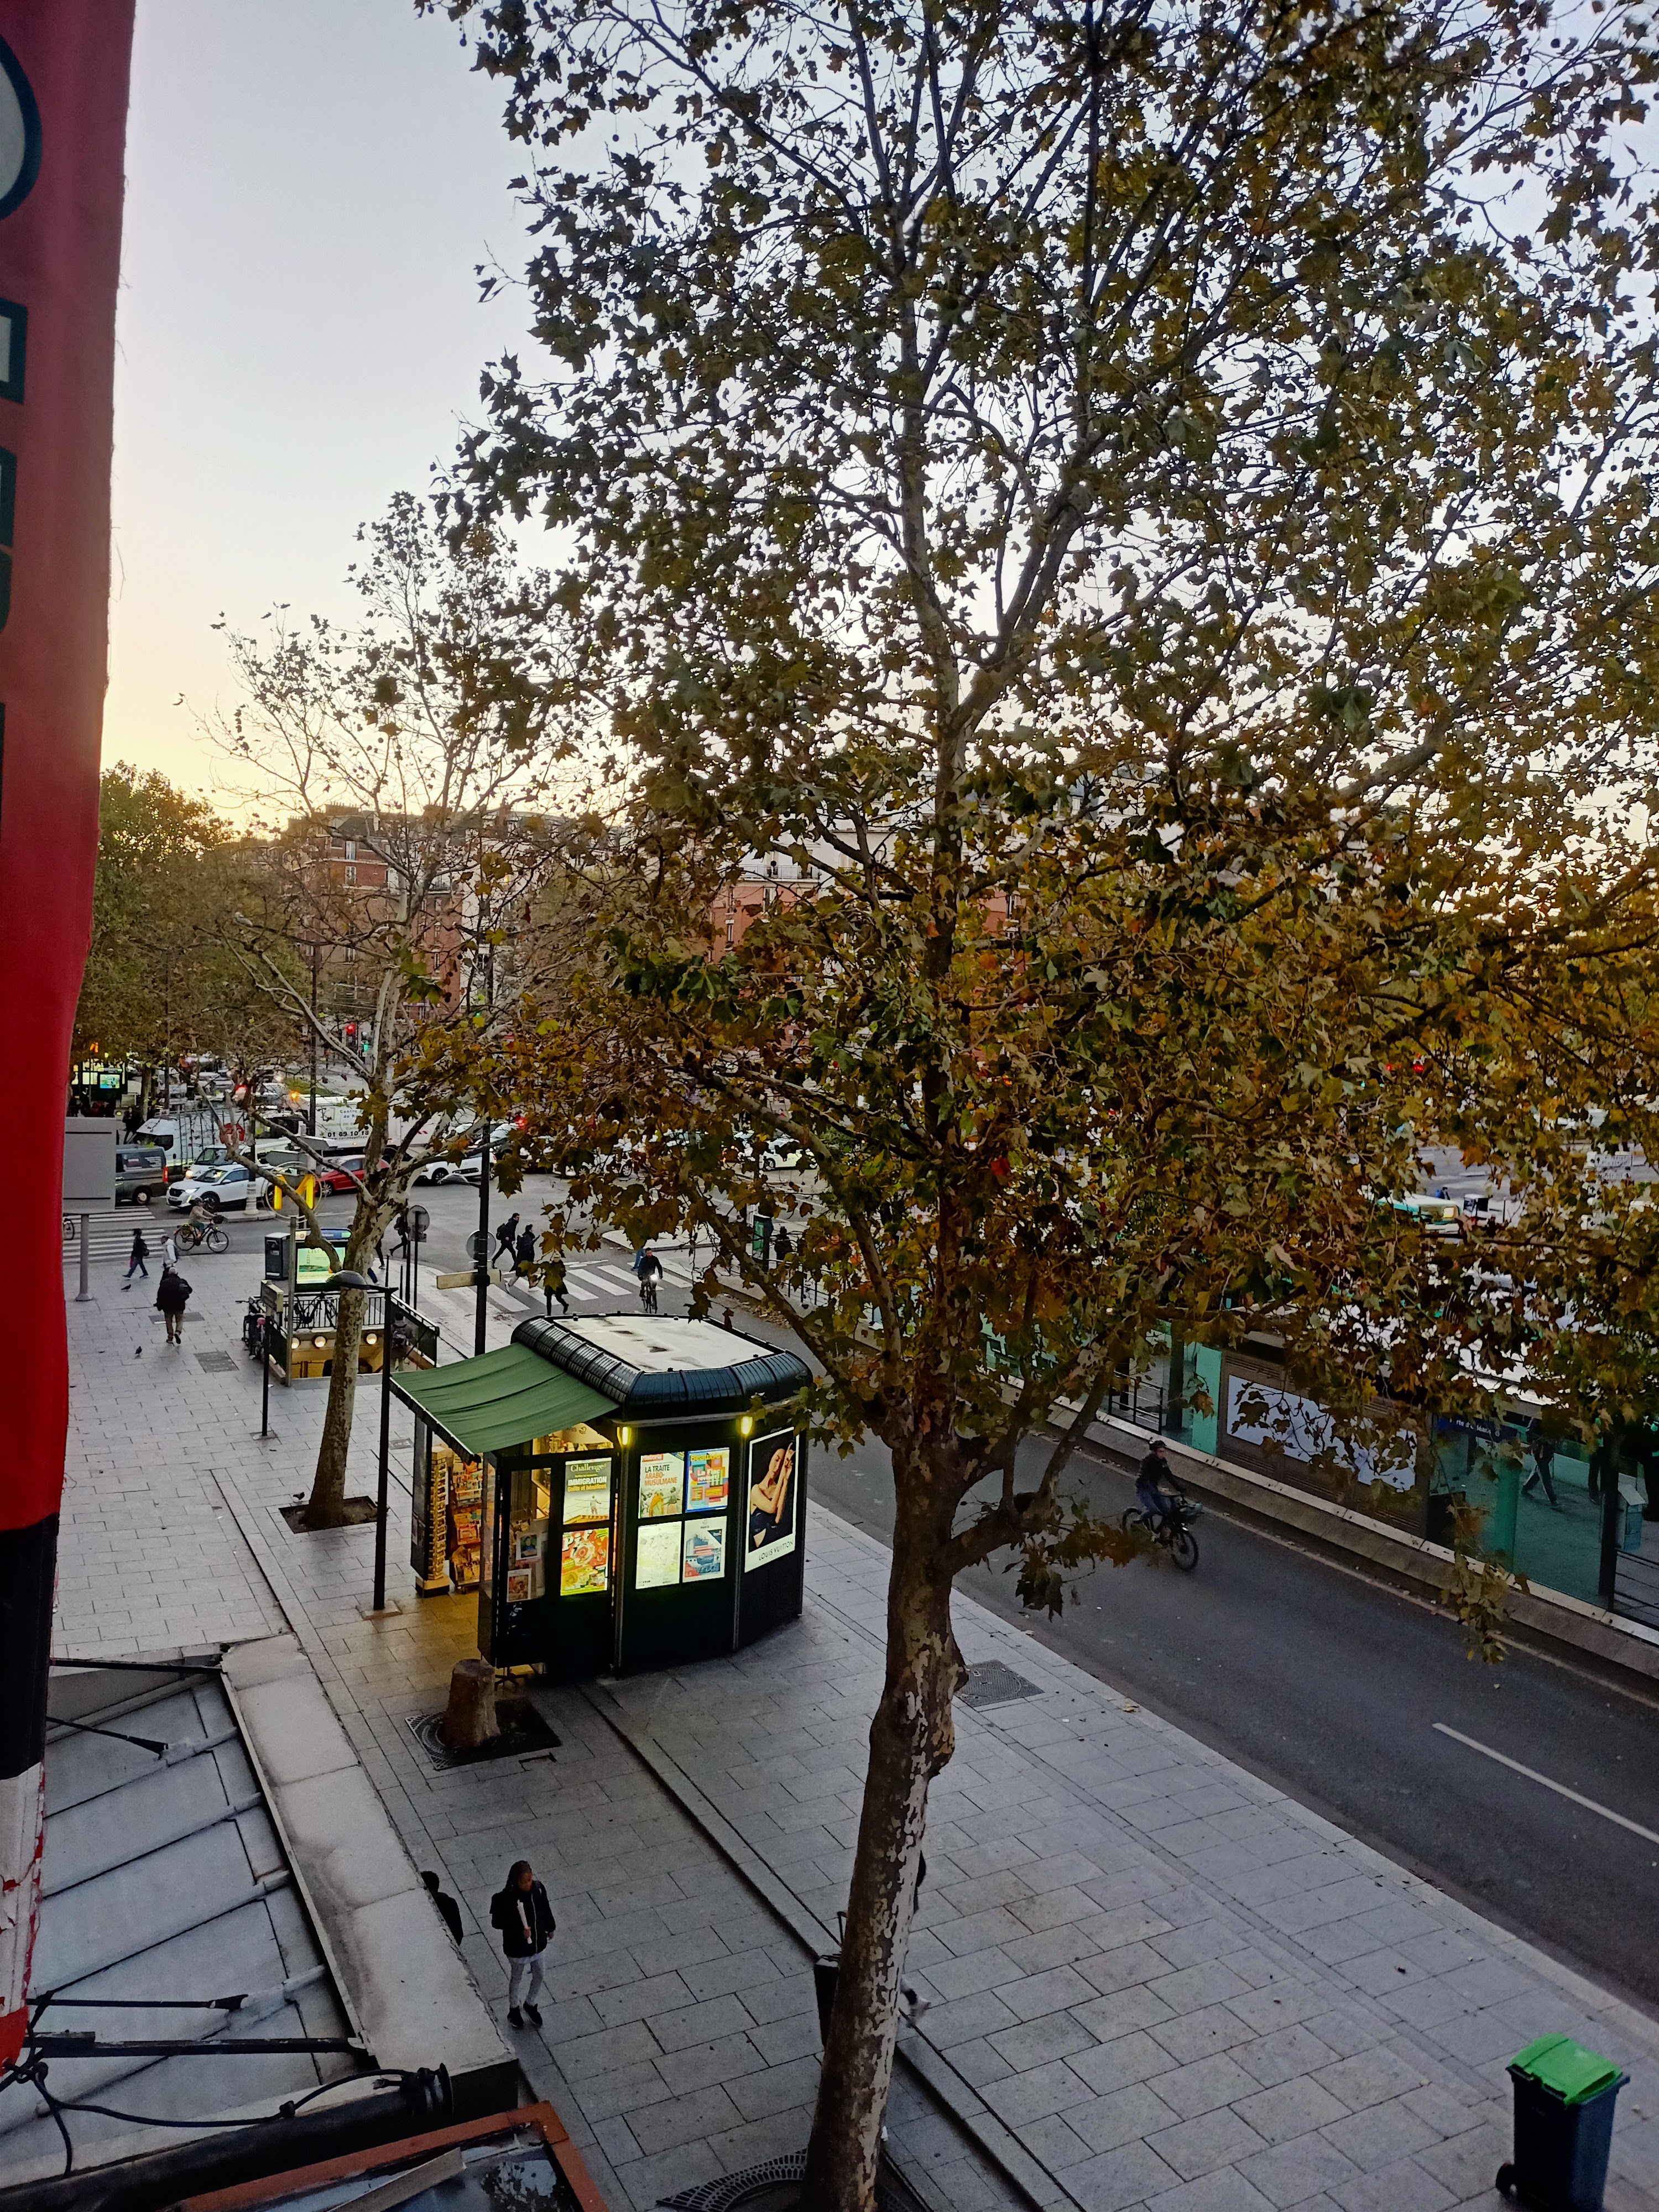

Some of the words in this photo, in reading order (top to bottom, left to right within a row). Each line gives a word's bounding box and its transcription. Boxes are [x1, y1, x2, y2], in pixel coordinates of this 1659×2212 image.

[567, 1476, 607, 1486] IMMIGRATION
[644, 1477, 677, 1486] MUSULMANE
[759, 1549, 773, 1561] LOUIS
[774, 1540, 794, 1552] VUITTON
